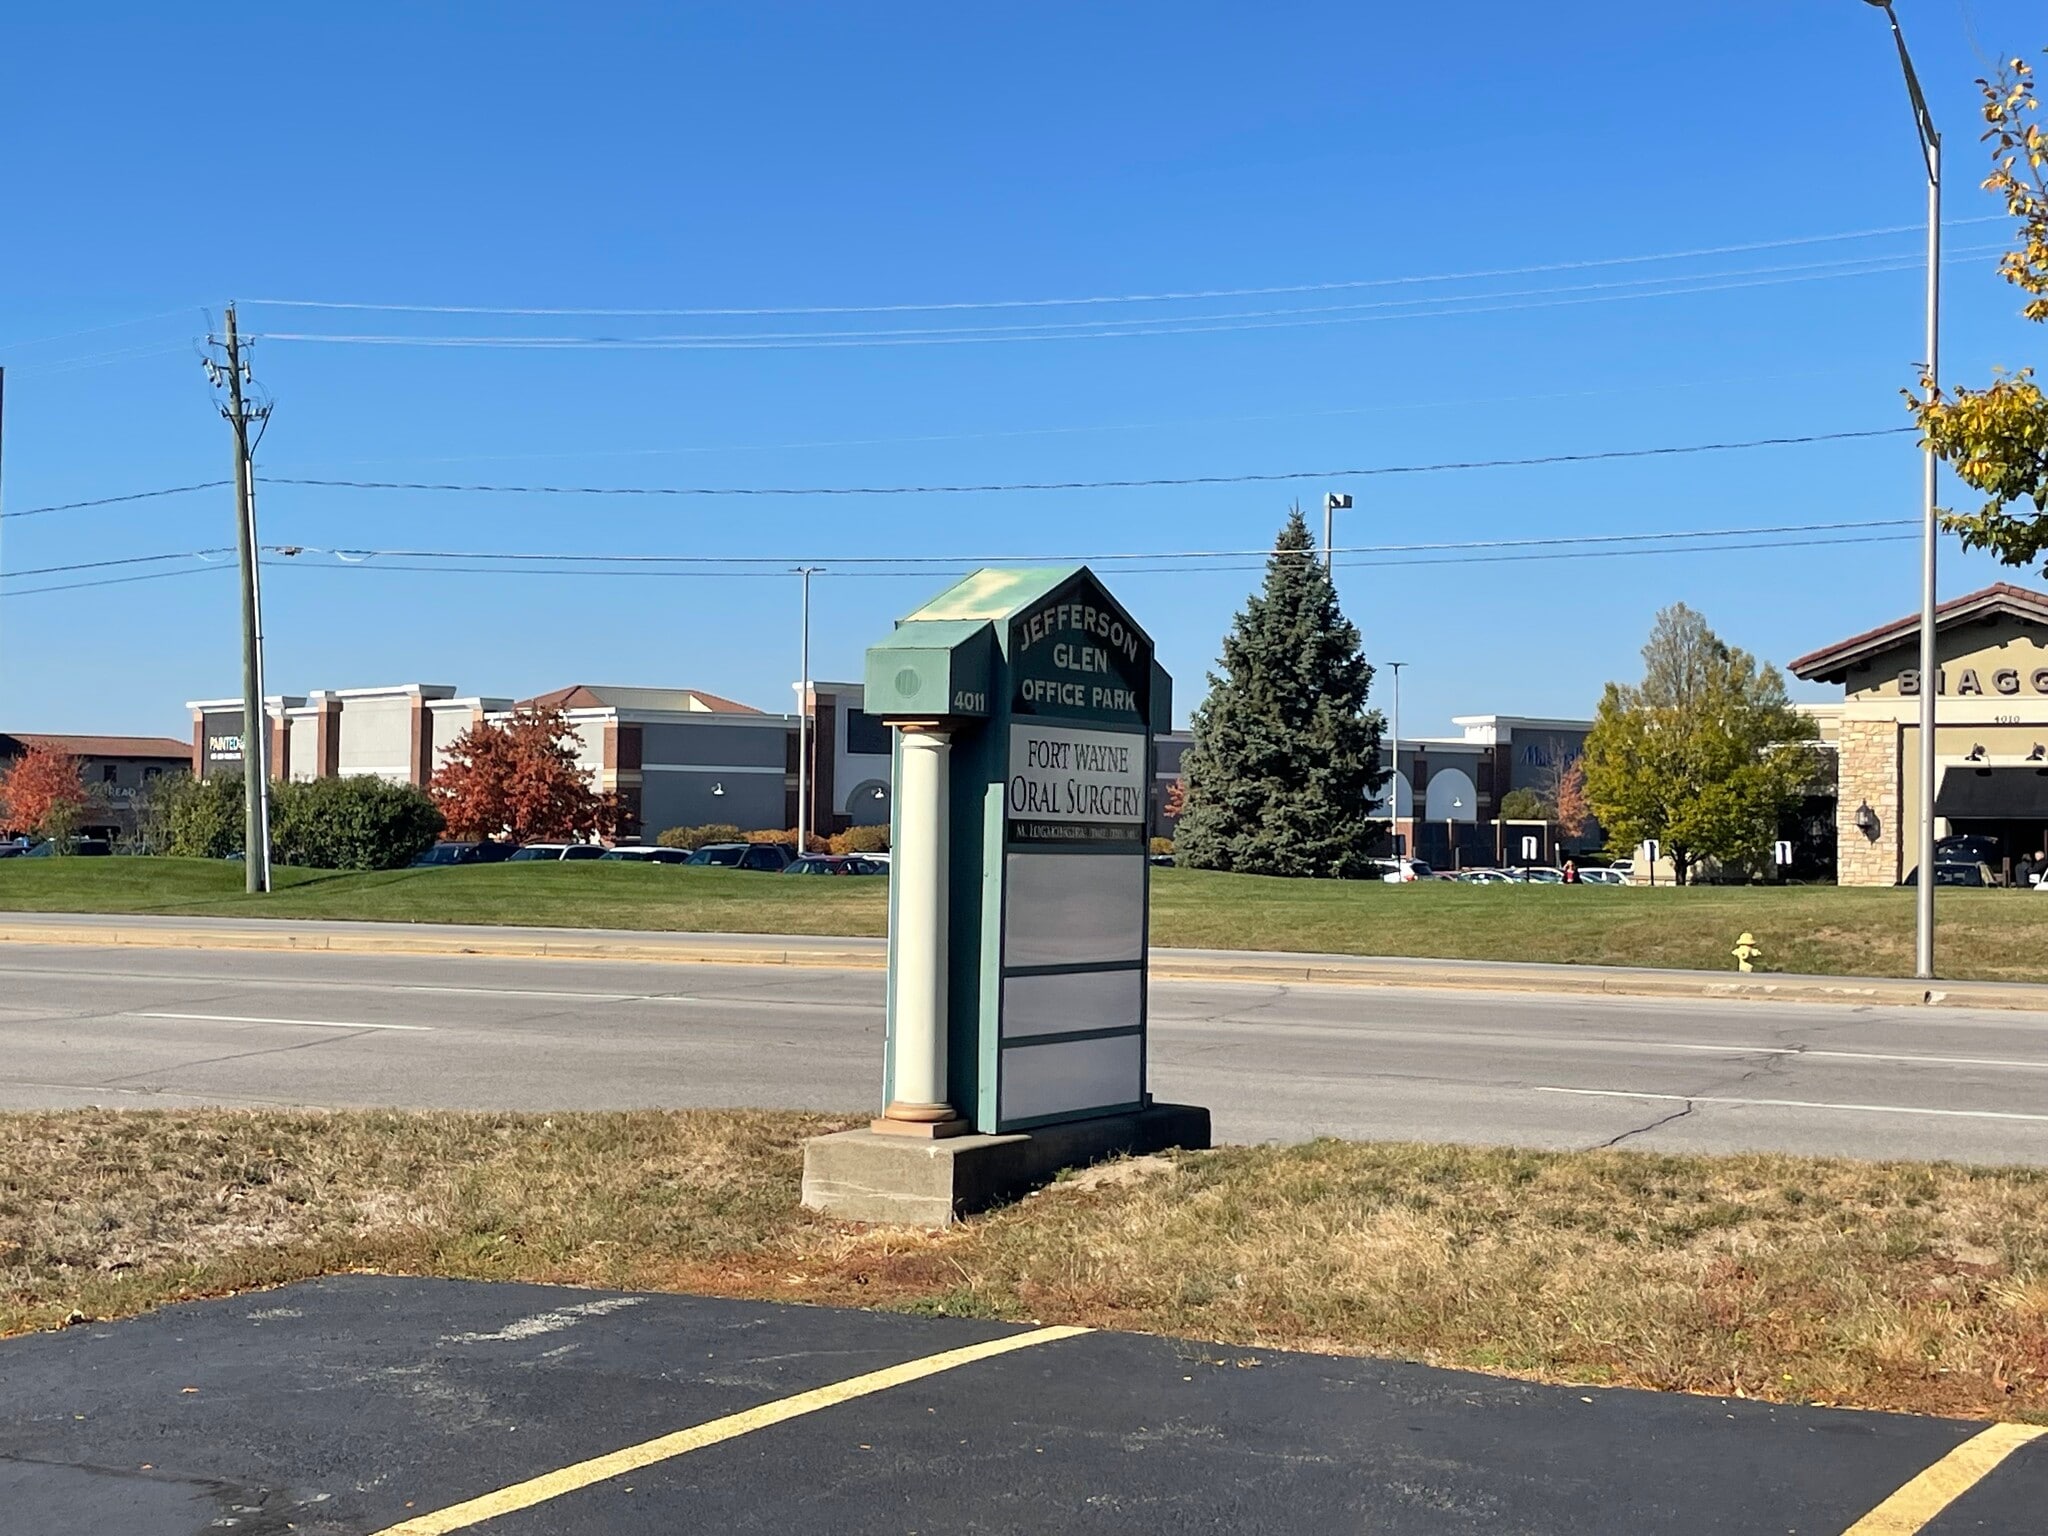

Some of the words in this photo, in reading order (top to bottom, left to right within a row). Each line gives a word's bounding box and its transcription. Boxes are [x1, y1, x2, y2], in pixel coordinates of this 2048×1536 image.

[1021, 604, 1138, 663] JEFFERSON
[1053, 643, 1108, 673] GLEN
[954, 690, 985, 712] 4011
[1022, 679, 1086, 706] OFFICE
[1092, 686, 1136, 712] PARK
[1028, 740, 1071, 769] FORT
[1074, 743, 1129, 773] WAYNE
[1011, 775, 1060, 813] ORAL
[1067, 778, 1140, 816] SURGERY
